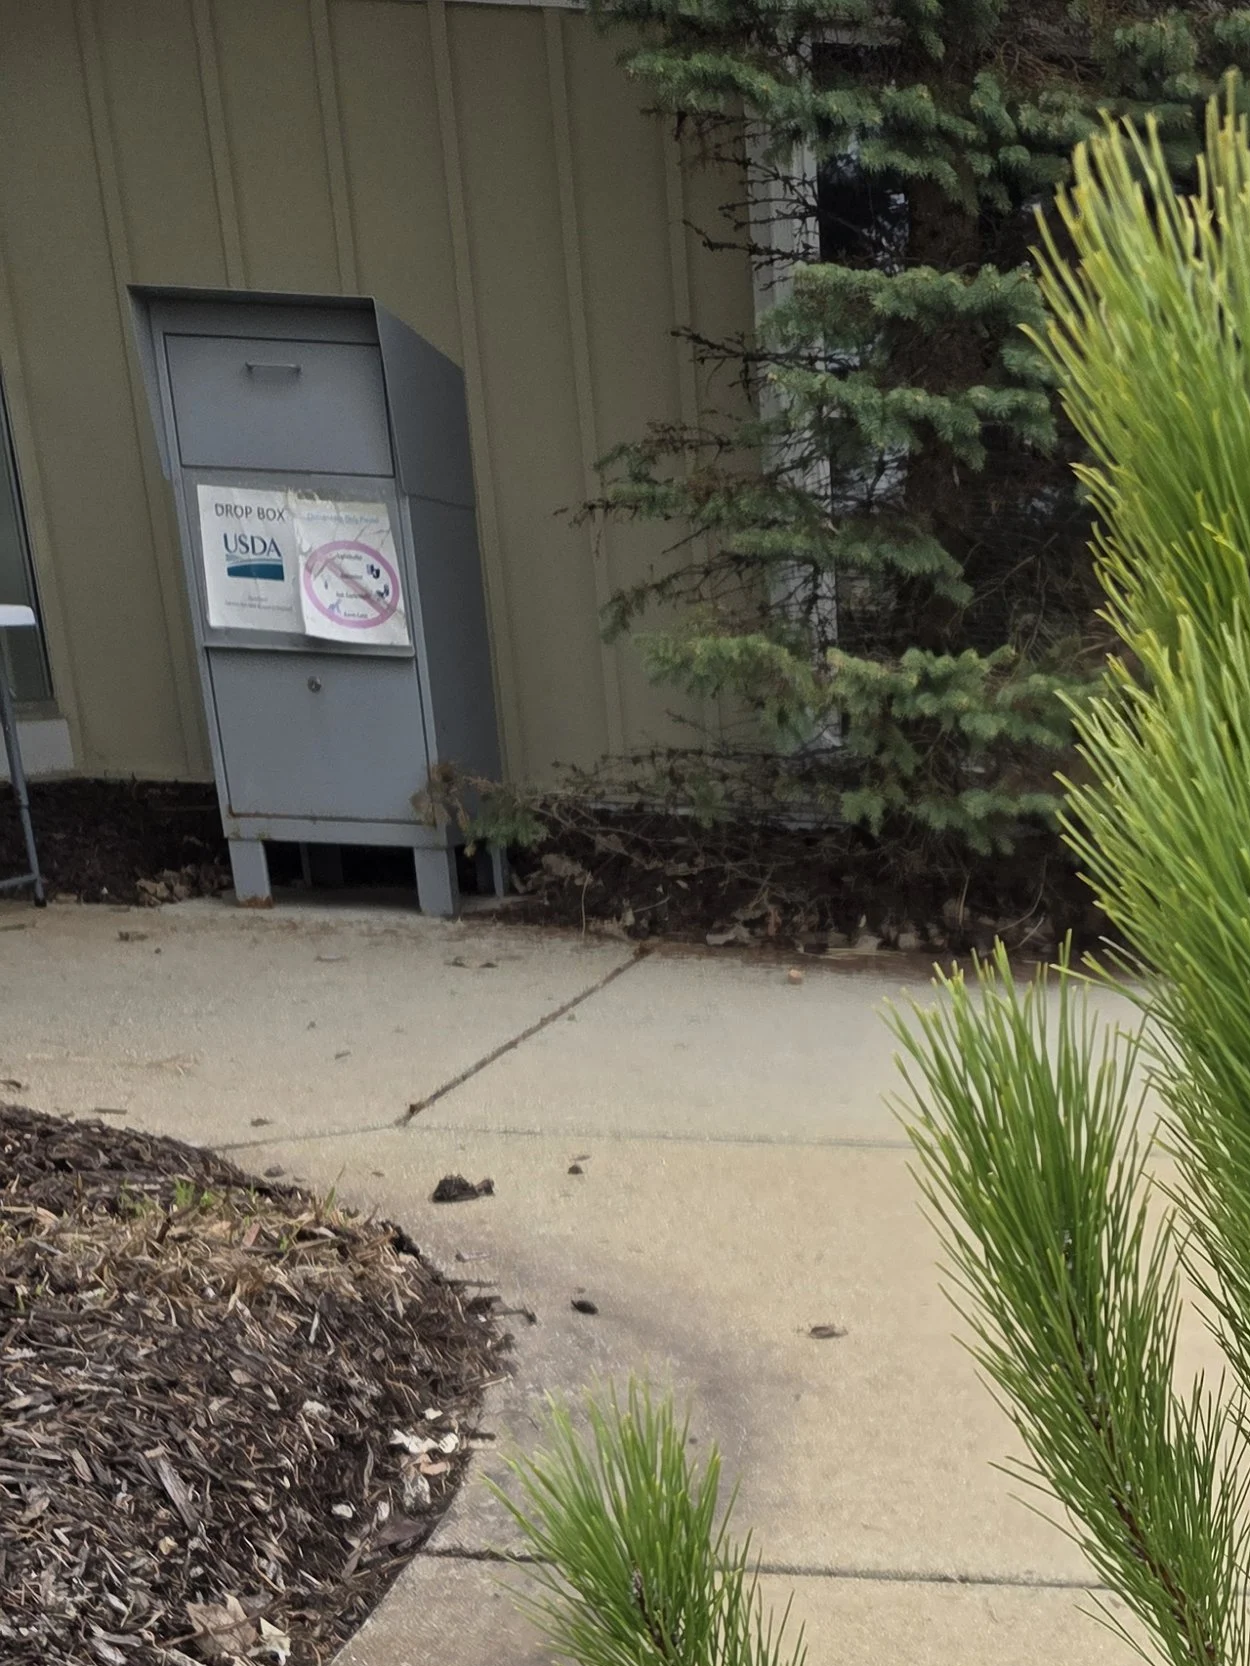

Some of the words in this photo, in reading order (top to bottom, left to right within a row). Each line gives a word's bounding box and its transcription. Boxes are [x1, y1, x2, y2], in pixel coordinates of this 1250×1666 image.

[214, 503, 253, 520] DROP
[257, 507, 286, 522] BOX
[223, 532, 282, 558] USDA
